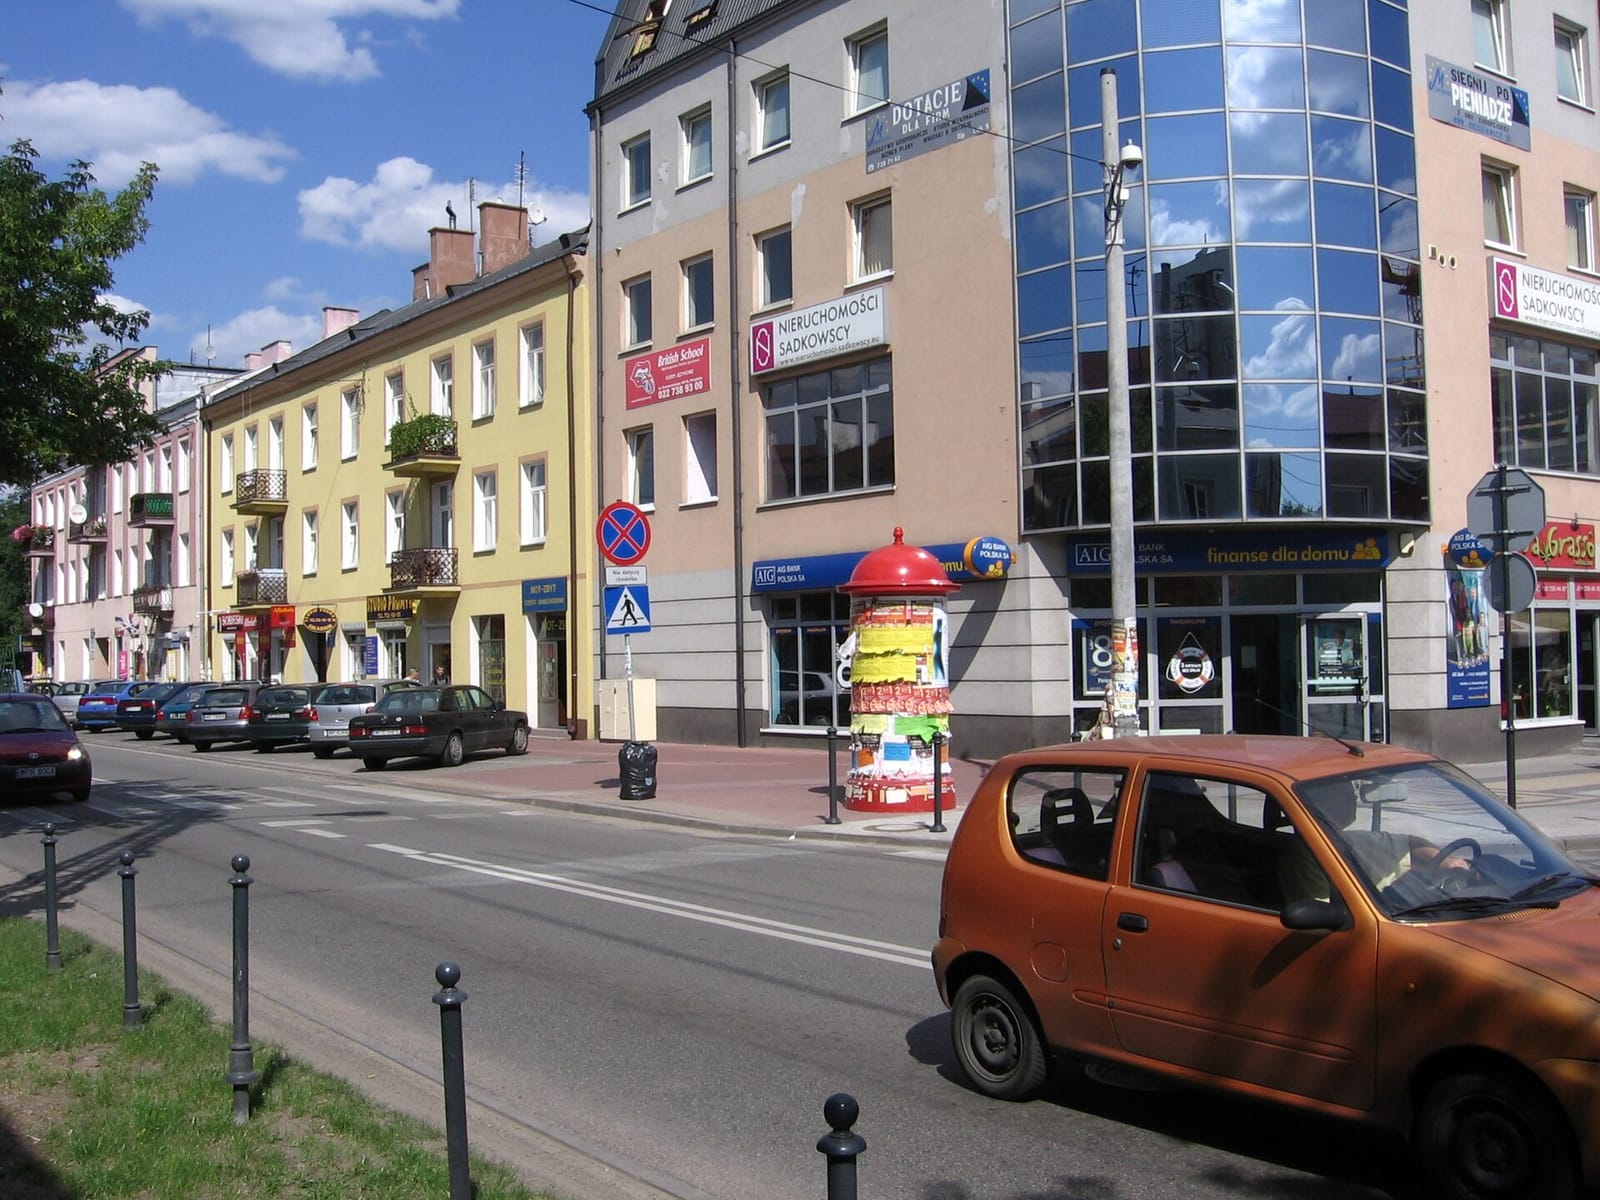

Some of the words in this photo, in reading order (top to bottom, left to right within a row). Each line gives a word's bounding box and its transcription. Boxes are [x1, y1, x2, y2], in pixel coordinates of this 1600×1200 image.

[1497, 86, 1510, 101] PO
[892, 82, 962, 126] DOTACJE
[902, 121, 920, 135] DLA
[926, 109, 950, 126] FIRM
[779, 294, 879, 335] NIERUCHOMOŚCI
[1523, 295, 1584, 323] SADKOWSCY
[779, 324, 851, 356] SADKOWSCY
[658, 352, 679, 368] British
[680, 344, 704, 362] School
[658, 388, 670, 399] 022
[1079, 548, 1112, 563] AIG
[1160, 554, 1173, 563] SA
[1207, 546, 1268, 563] finanse
[1272, 546, 1298, 562] dla
[1301, 546, 1348, 561] domu
[757, 569, 774, 583] AIG
[787, 565, 801, 573] BANK
[778, 575, 797, 583] POLSKA
